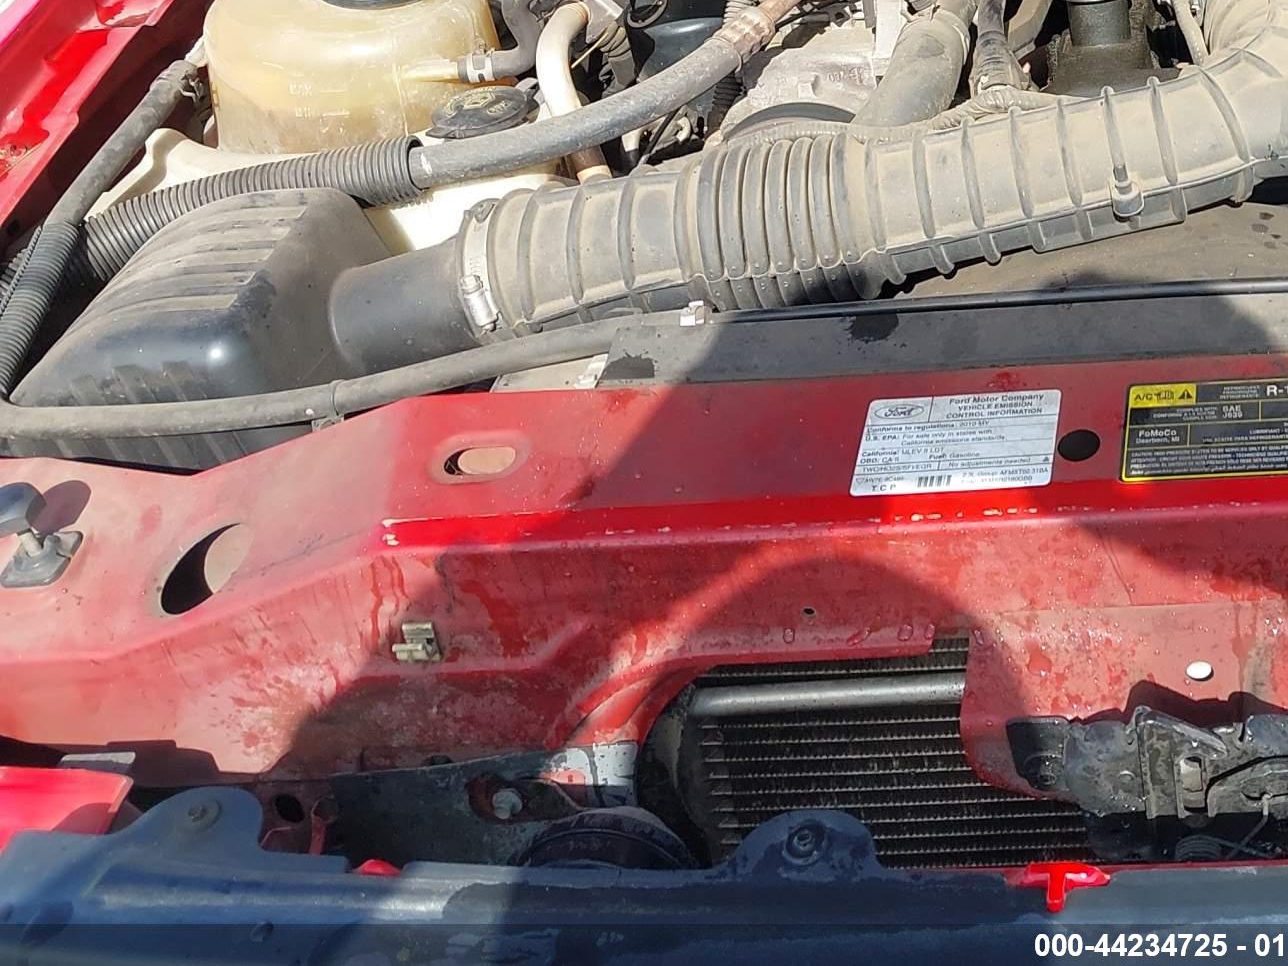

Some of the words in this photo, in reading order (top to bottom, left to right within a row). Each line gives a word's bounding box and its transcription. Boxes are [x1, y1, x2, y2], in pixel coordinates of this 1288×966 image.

[949, 395, 970, 405] Ford
[972, 394, 999, 404] Motor
[1001, 392, 1045, 402] Company
[1134, 393, 1153, 402] A/C
[883, 406, 914, 418] Ford
[958, 403, 993, 412] VEHICLE
[994, 401, 1033, 410] EMISSION
[946, 411, 984, 420] CONTROL
[987, 408, 1043, 418] INFORMATION
[1138, 429, 1177, 438] FoMoCo
